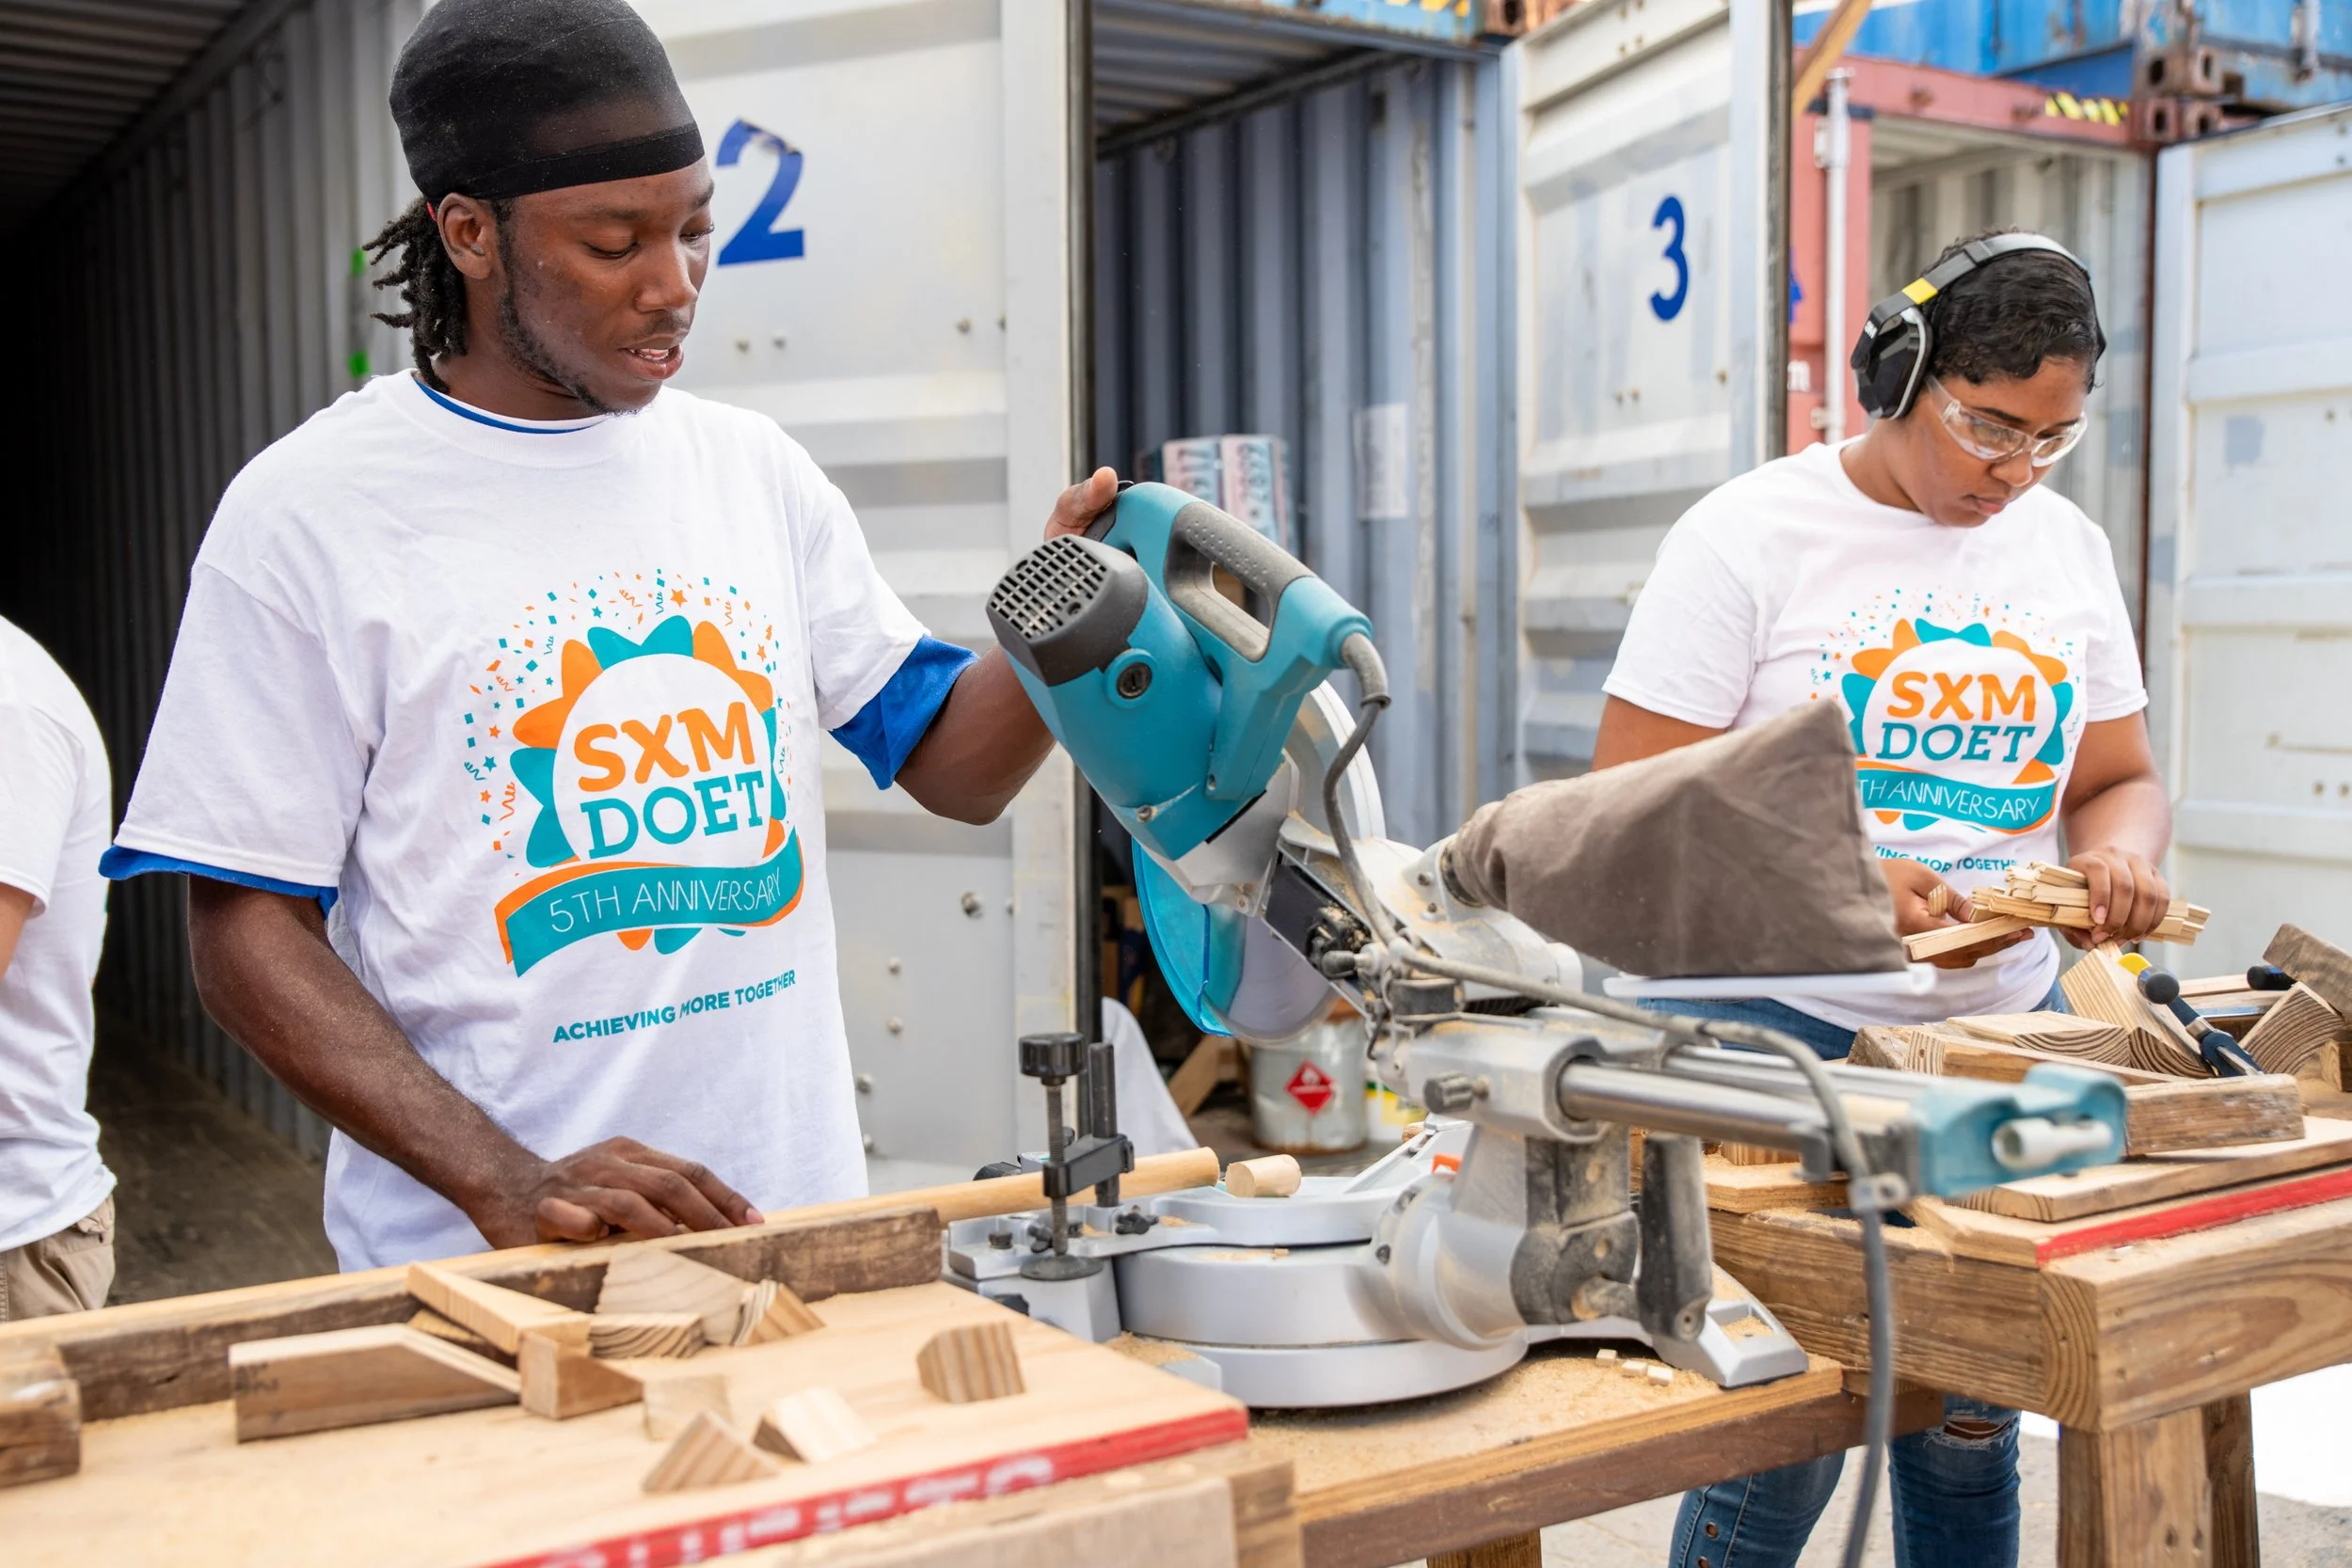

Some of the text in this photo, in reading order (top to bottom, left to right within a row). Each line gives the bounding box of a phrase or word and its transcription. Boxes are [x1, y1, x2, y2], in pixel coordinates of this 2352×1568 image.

[715, 119, 805, 267] 2
[1650, 196, 1689, 322] 3
[1886, 672, 2036, 721] SXM
[573, 702, 755, 792] SXM
[1875, 722, 2036, 763] DOET
[580, 769, 764, 860] DOET
[1858, 779, 2040, 821] TH ANNIVERSARY
[549, 866, 781, 933] 5TH ANNIVERSARY
[552, 969, 796, 1043] ACHIEVING MORE TOGETHER
